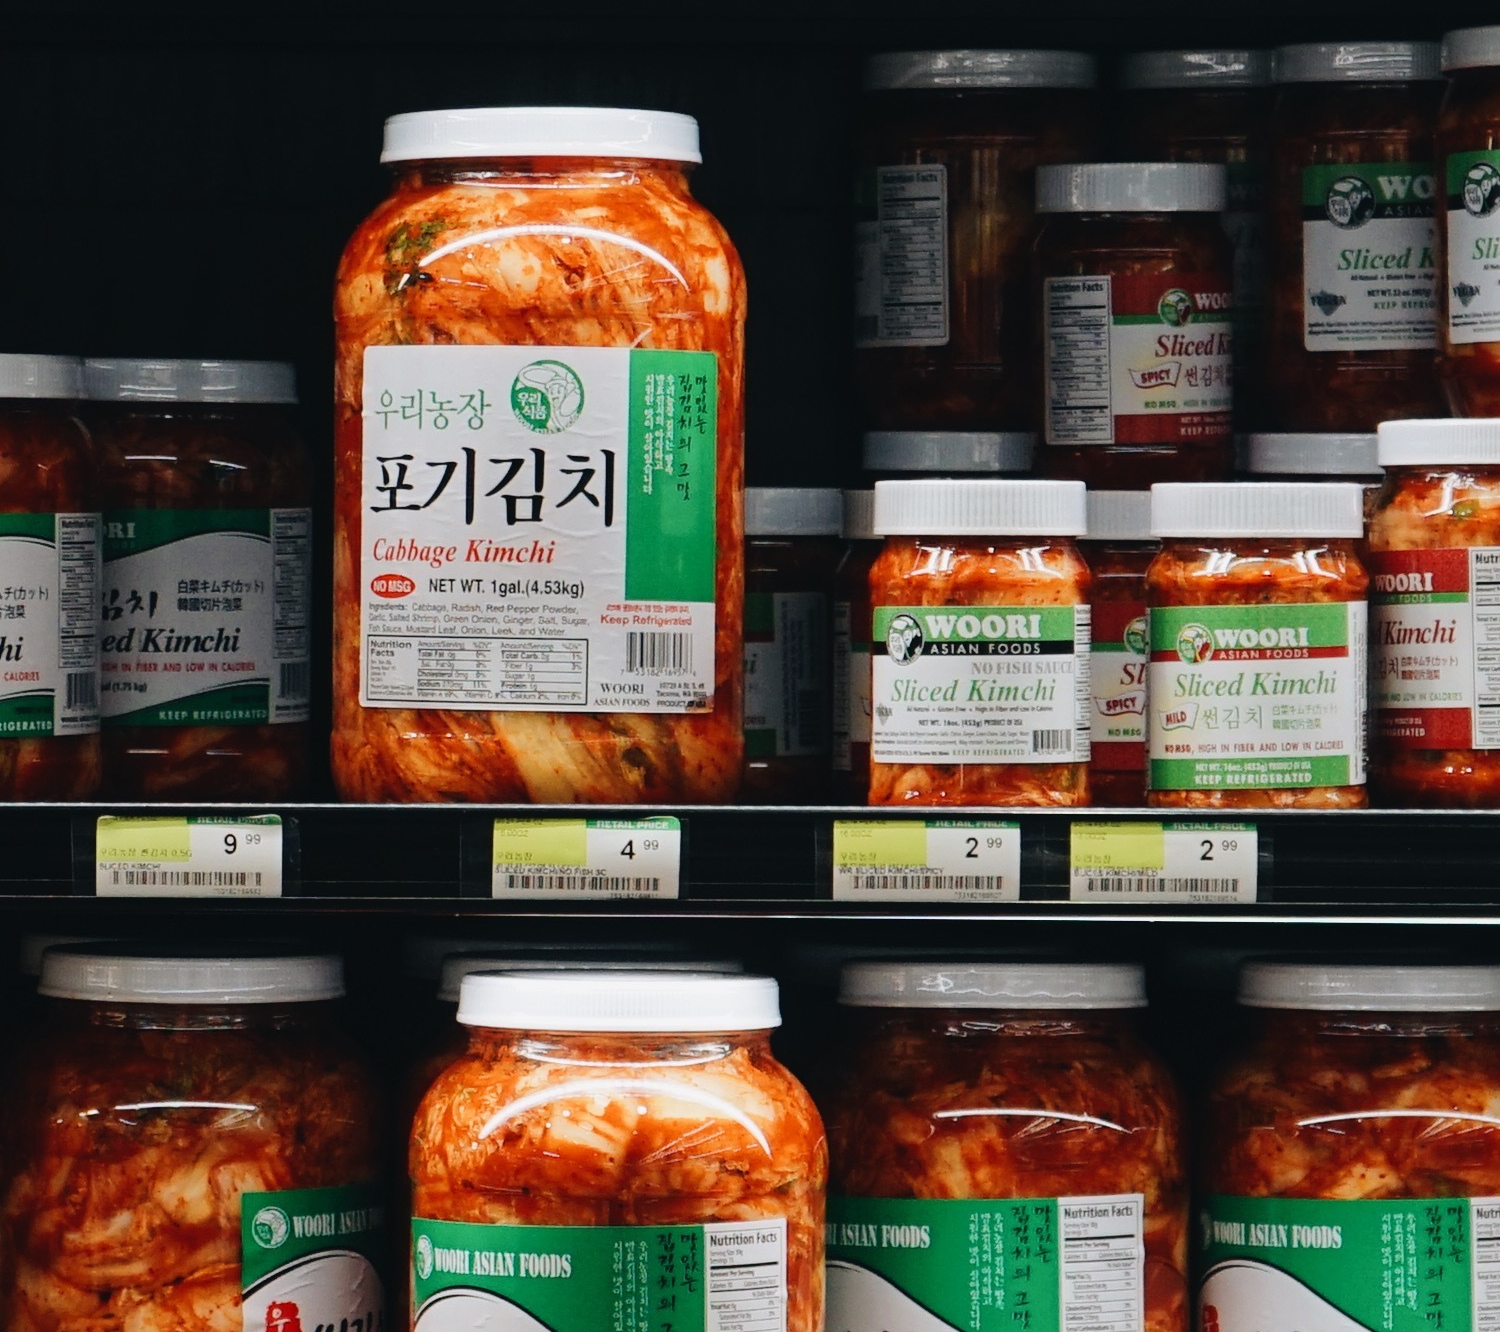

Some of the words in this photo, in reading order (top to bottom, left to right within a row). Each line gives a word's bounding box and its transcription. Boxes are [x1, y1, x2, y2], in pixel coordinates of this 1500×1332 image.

[375, 389, 492, 431] 우리농장
[370, 447, 616, 527] 포기김치
[373, 538, 457, 567] Cabbage
[466, 538, 554, 563] Kimchi
[373, 578, 387, 594] NO
[388, 578, 411, 594] MSG
[428, 579, 456, 594] NET
[461, 579, 485, 594] WT.
[490, 578, 585, 598] 1gal.(4.53kg)
[927, 614, 1041, 638] WOORI
[931, 642, 982, 654] ASIAN
[989, 642, 1042, 654] FOODS
[892, 679, 960, 703] Sliced
[967, 677, 1056, 701] Kimchi
[1174, 672, 1244, 697] Sliced
[1251, 670, 1337, 694] Kimchi
[223, 833, 238, 854] 9
[245, 833, 262, 846] 99
[620, 840, 635, 860] 4
[643, 840, 658, 851] 99
[965, 836, 979, 859] 2
[986, 837, 1003, 849] 99
[435, 1249, 469, 1275] WOORI
[473, 1251, 514, 1276] ASIAN
[520, 1253, 571, 1278] FOODS
